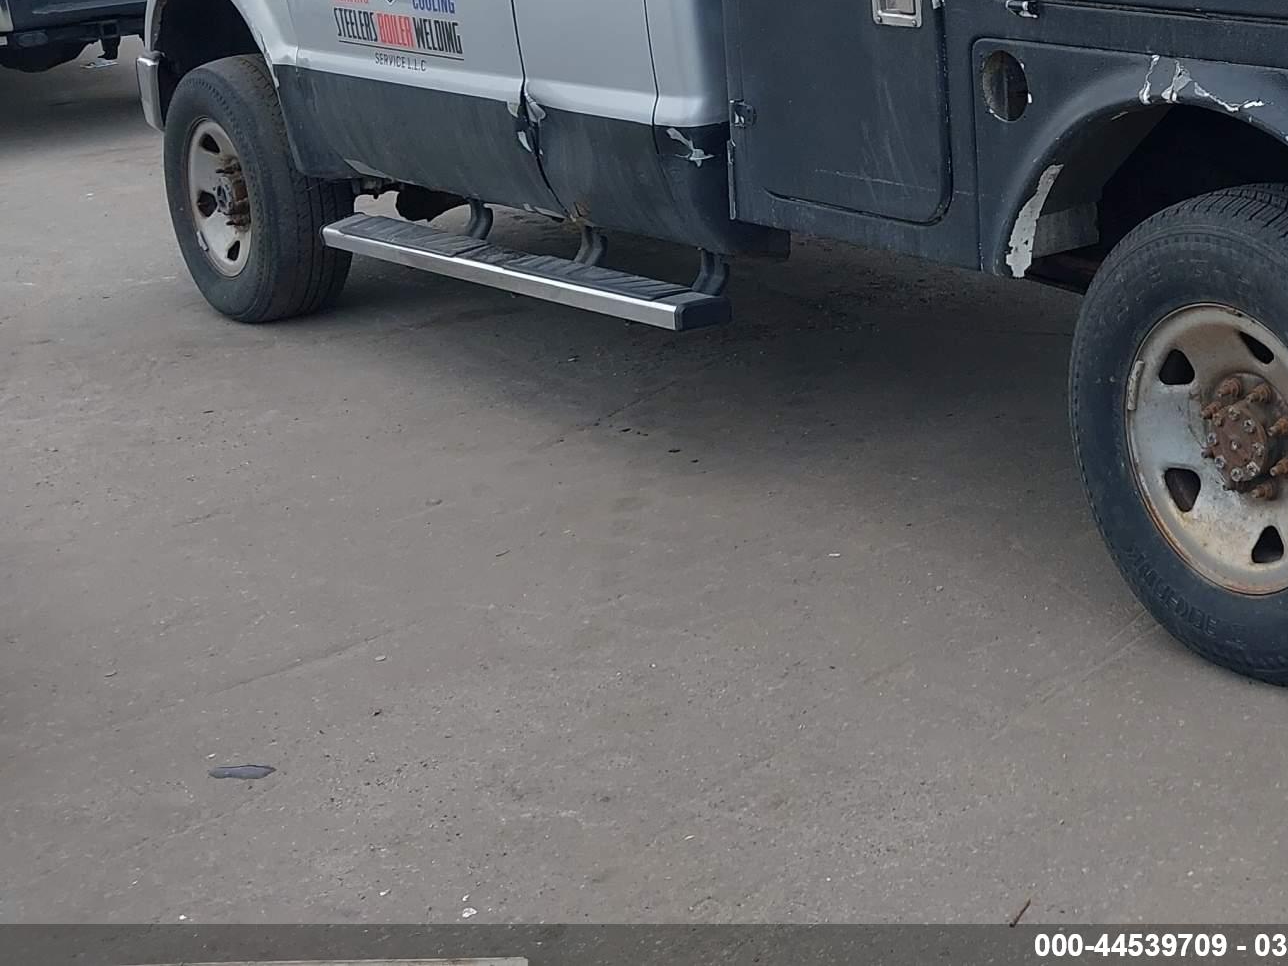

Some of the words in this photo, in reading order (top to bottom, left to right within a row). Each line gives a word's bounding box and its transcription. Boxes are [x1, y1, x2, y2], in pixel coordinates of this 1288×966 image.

[334, 8, 377, 42] STEELERS
[377, 13, 414, 47] BOILER
[412, 16, 464, 55] WELDING
[375, 52, 406, 69] SERVICE
